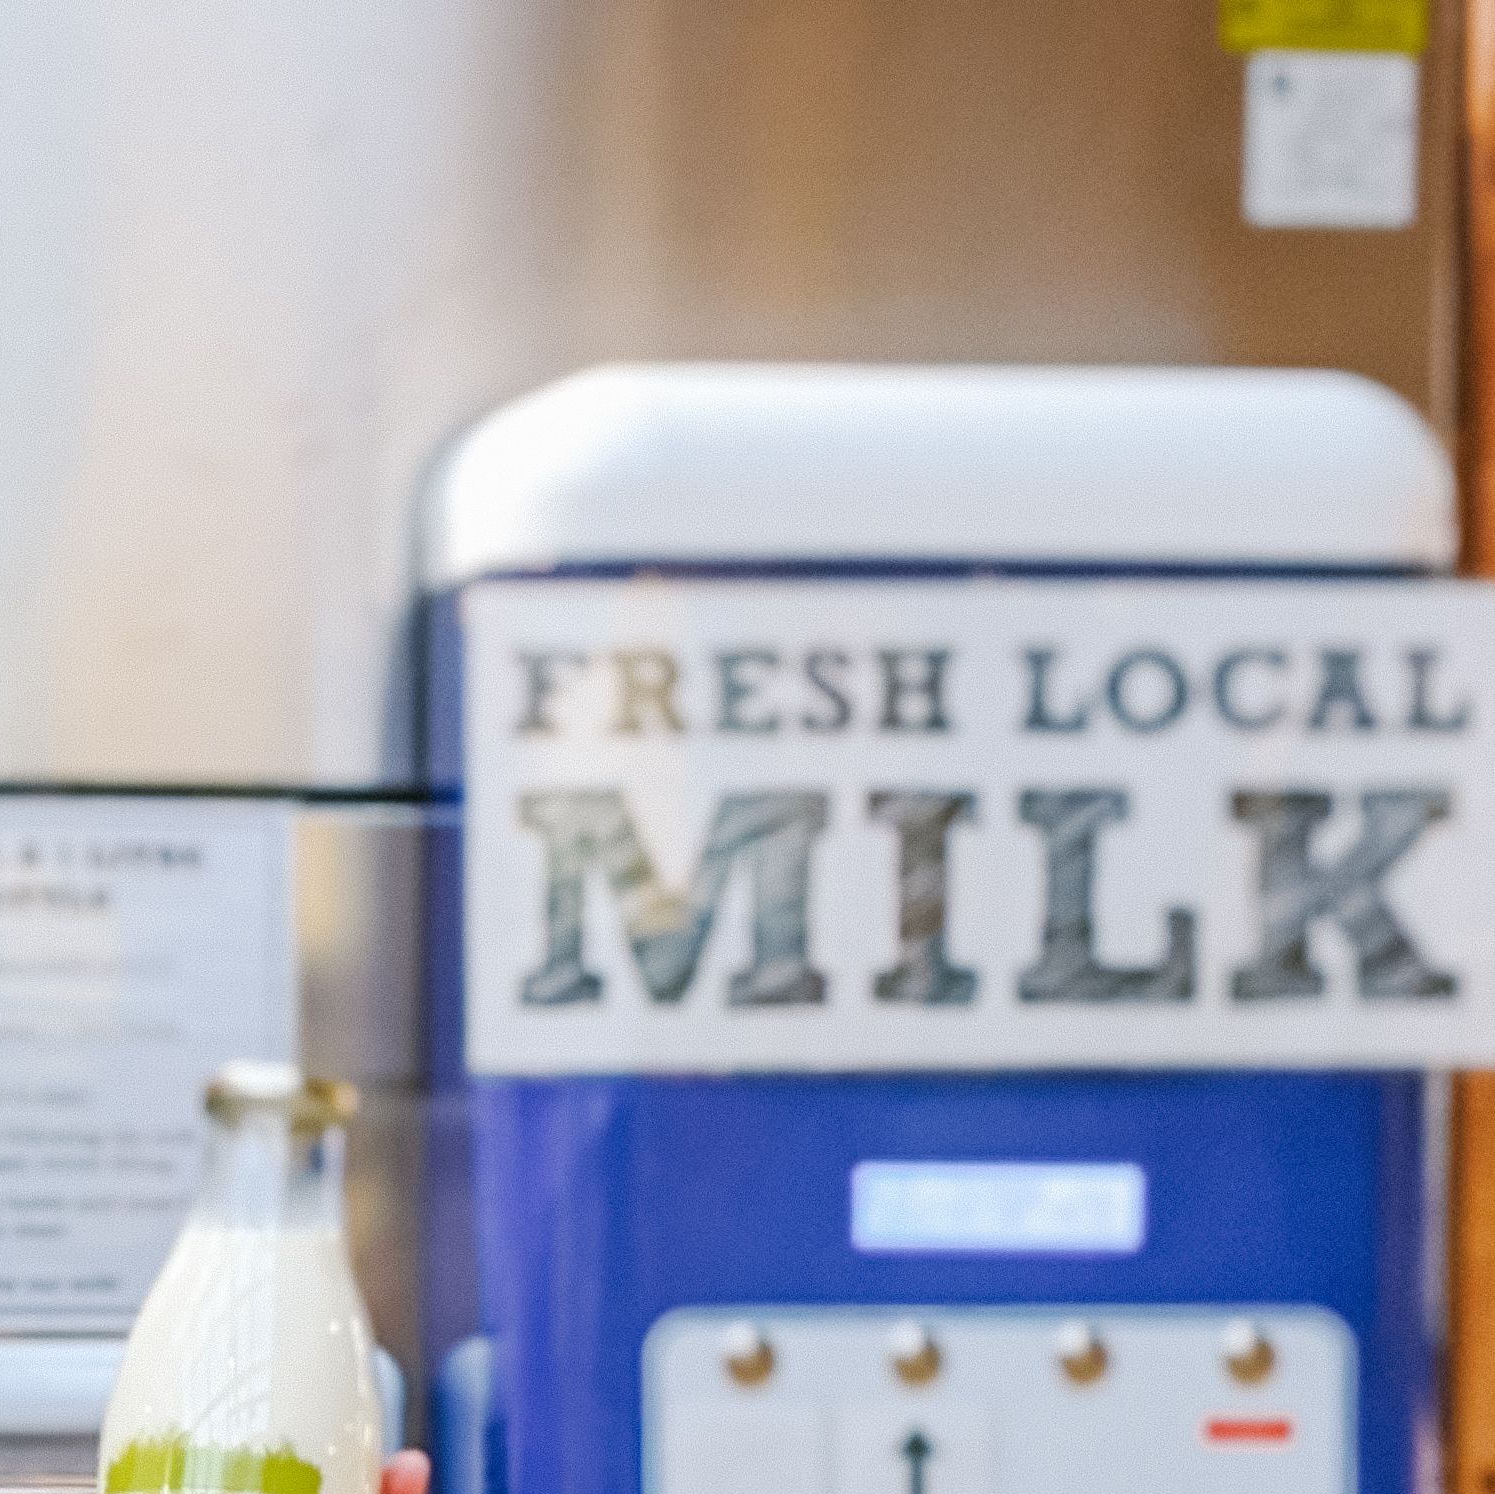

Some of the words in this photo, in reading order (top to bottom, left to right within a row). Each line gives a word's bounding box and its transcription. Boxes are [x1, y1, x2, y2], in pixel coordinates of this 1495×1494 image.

[511, 642, 954, 737] FRESH
[1018, 642, 1472, 737] LOCAL
[516, 786, 1462, 1008] MILK
